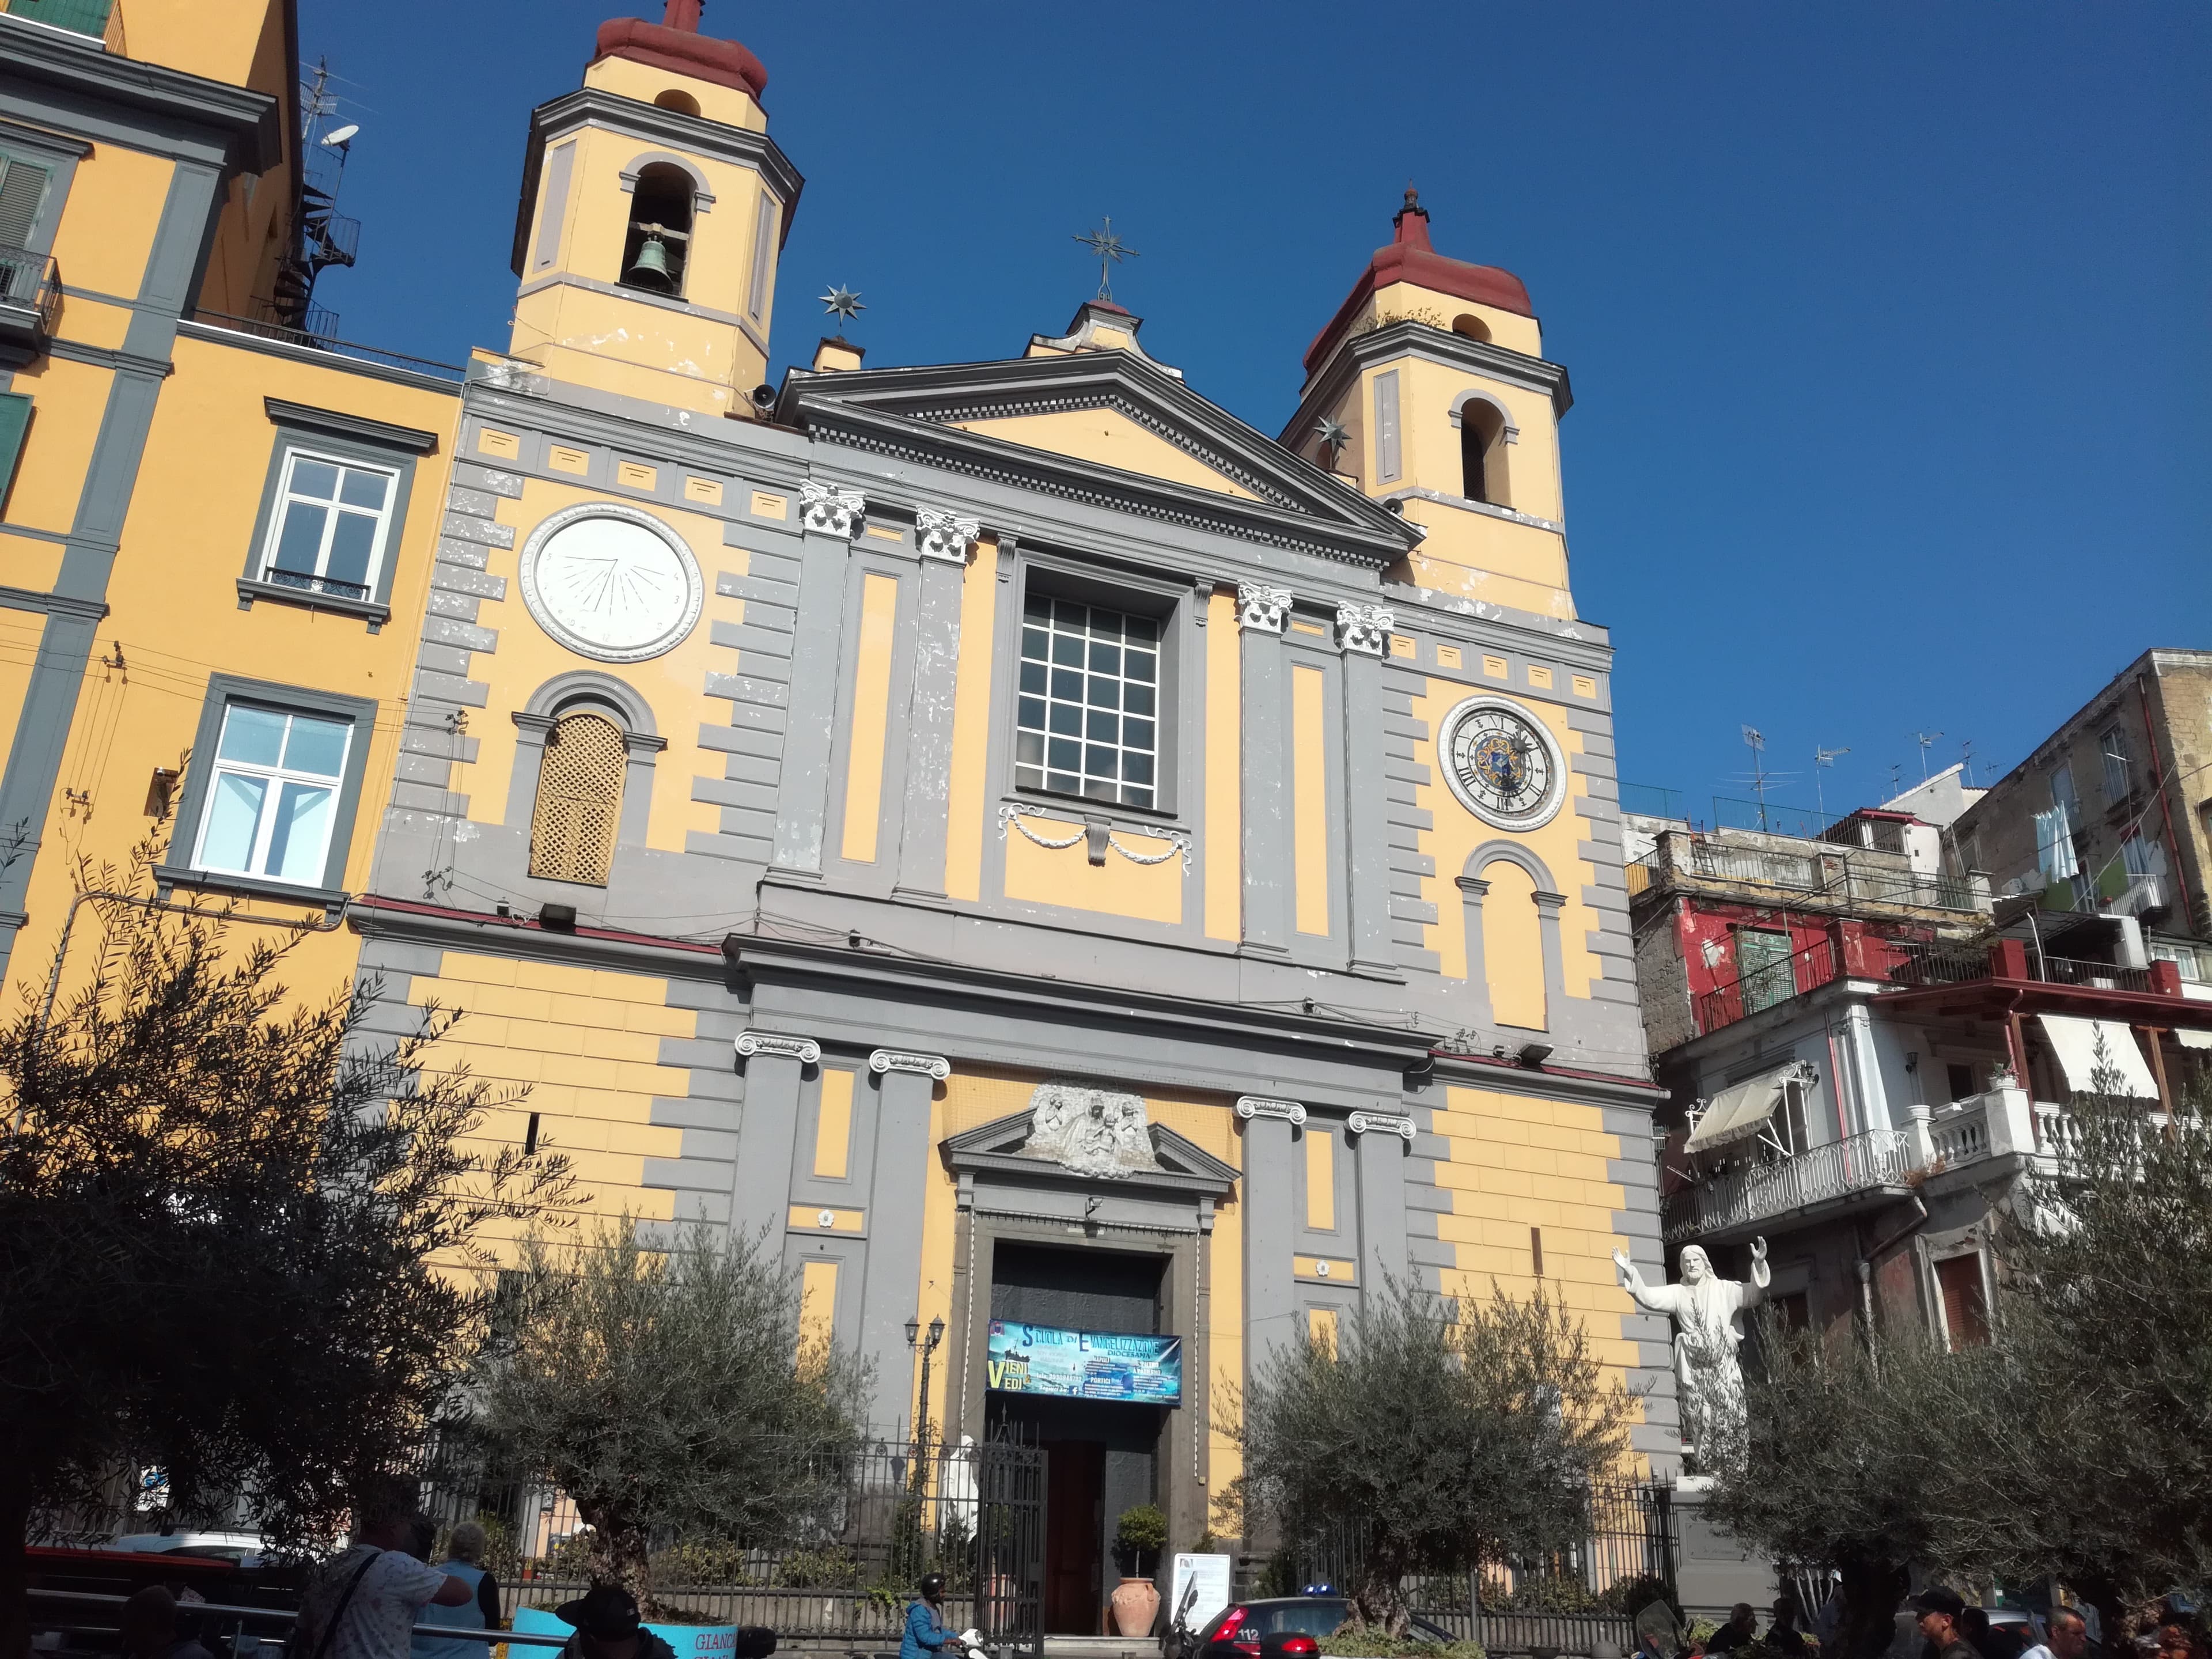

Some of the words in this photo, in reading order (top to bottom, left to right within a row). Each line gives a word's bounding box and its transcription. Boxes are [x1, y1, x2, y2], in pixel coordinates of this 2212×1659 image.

[673, 595, 680, 604] 3
[1022, 1324, 1063, 1347] SCUOLA
[1066, 1336, 1077, 1344] DI
[1079, 1332, 1160, 1354] EVANGELIZZAZIONE
[1107, 1350, 1150, 1359] DIOCESANA
[1238, 1628, 1260, 1641] 112
